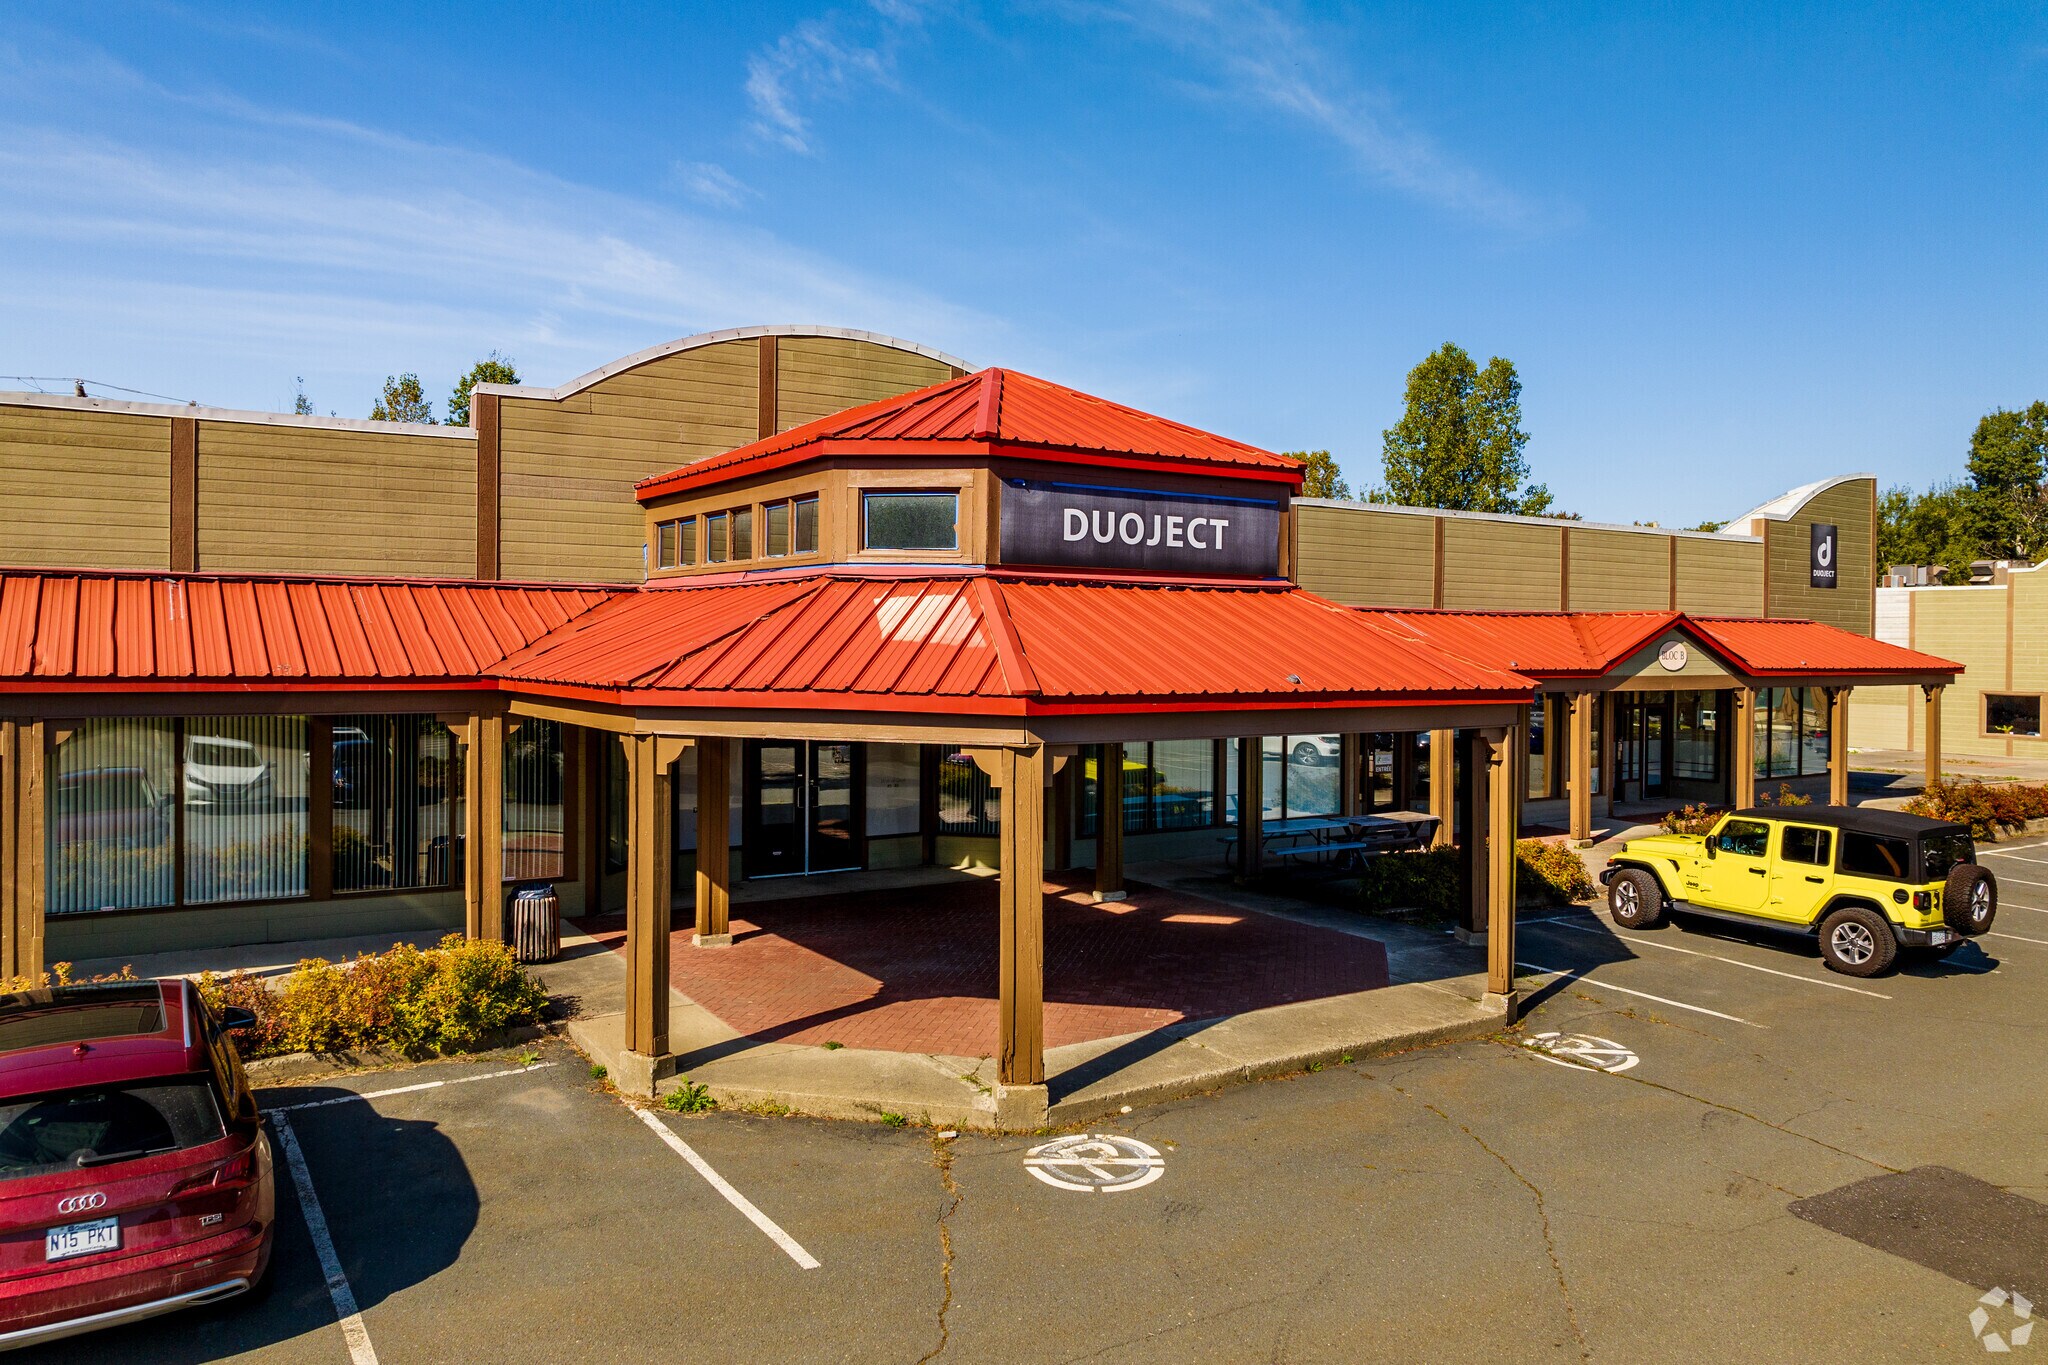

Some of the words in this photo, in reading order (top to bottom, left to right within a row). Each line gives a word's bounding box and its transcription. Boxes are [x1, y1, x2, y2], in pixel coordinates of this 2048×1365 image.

[1062, 507, 1229, 550] DUOJECT
[1817, 535, 1832, 567] d
[1812, 569, 1835, 578] DUOJECT
[1661, 650, 1679, 661] BLOC
[1680, 651, 1685, 660] B
[50, 1231, 79, 1252] N15
[88, 1224, 115, 1245] PKT
